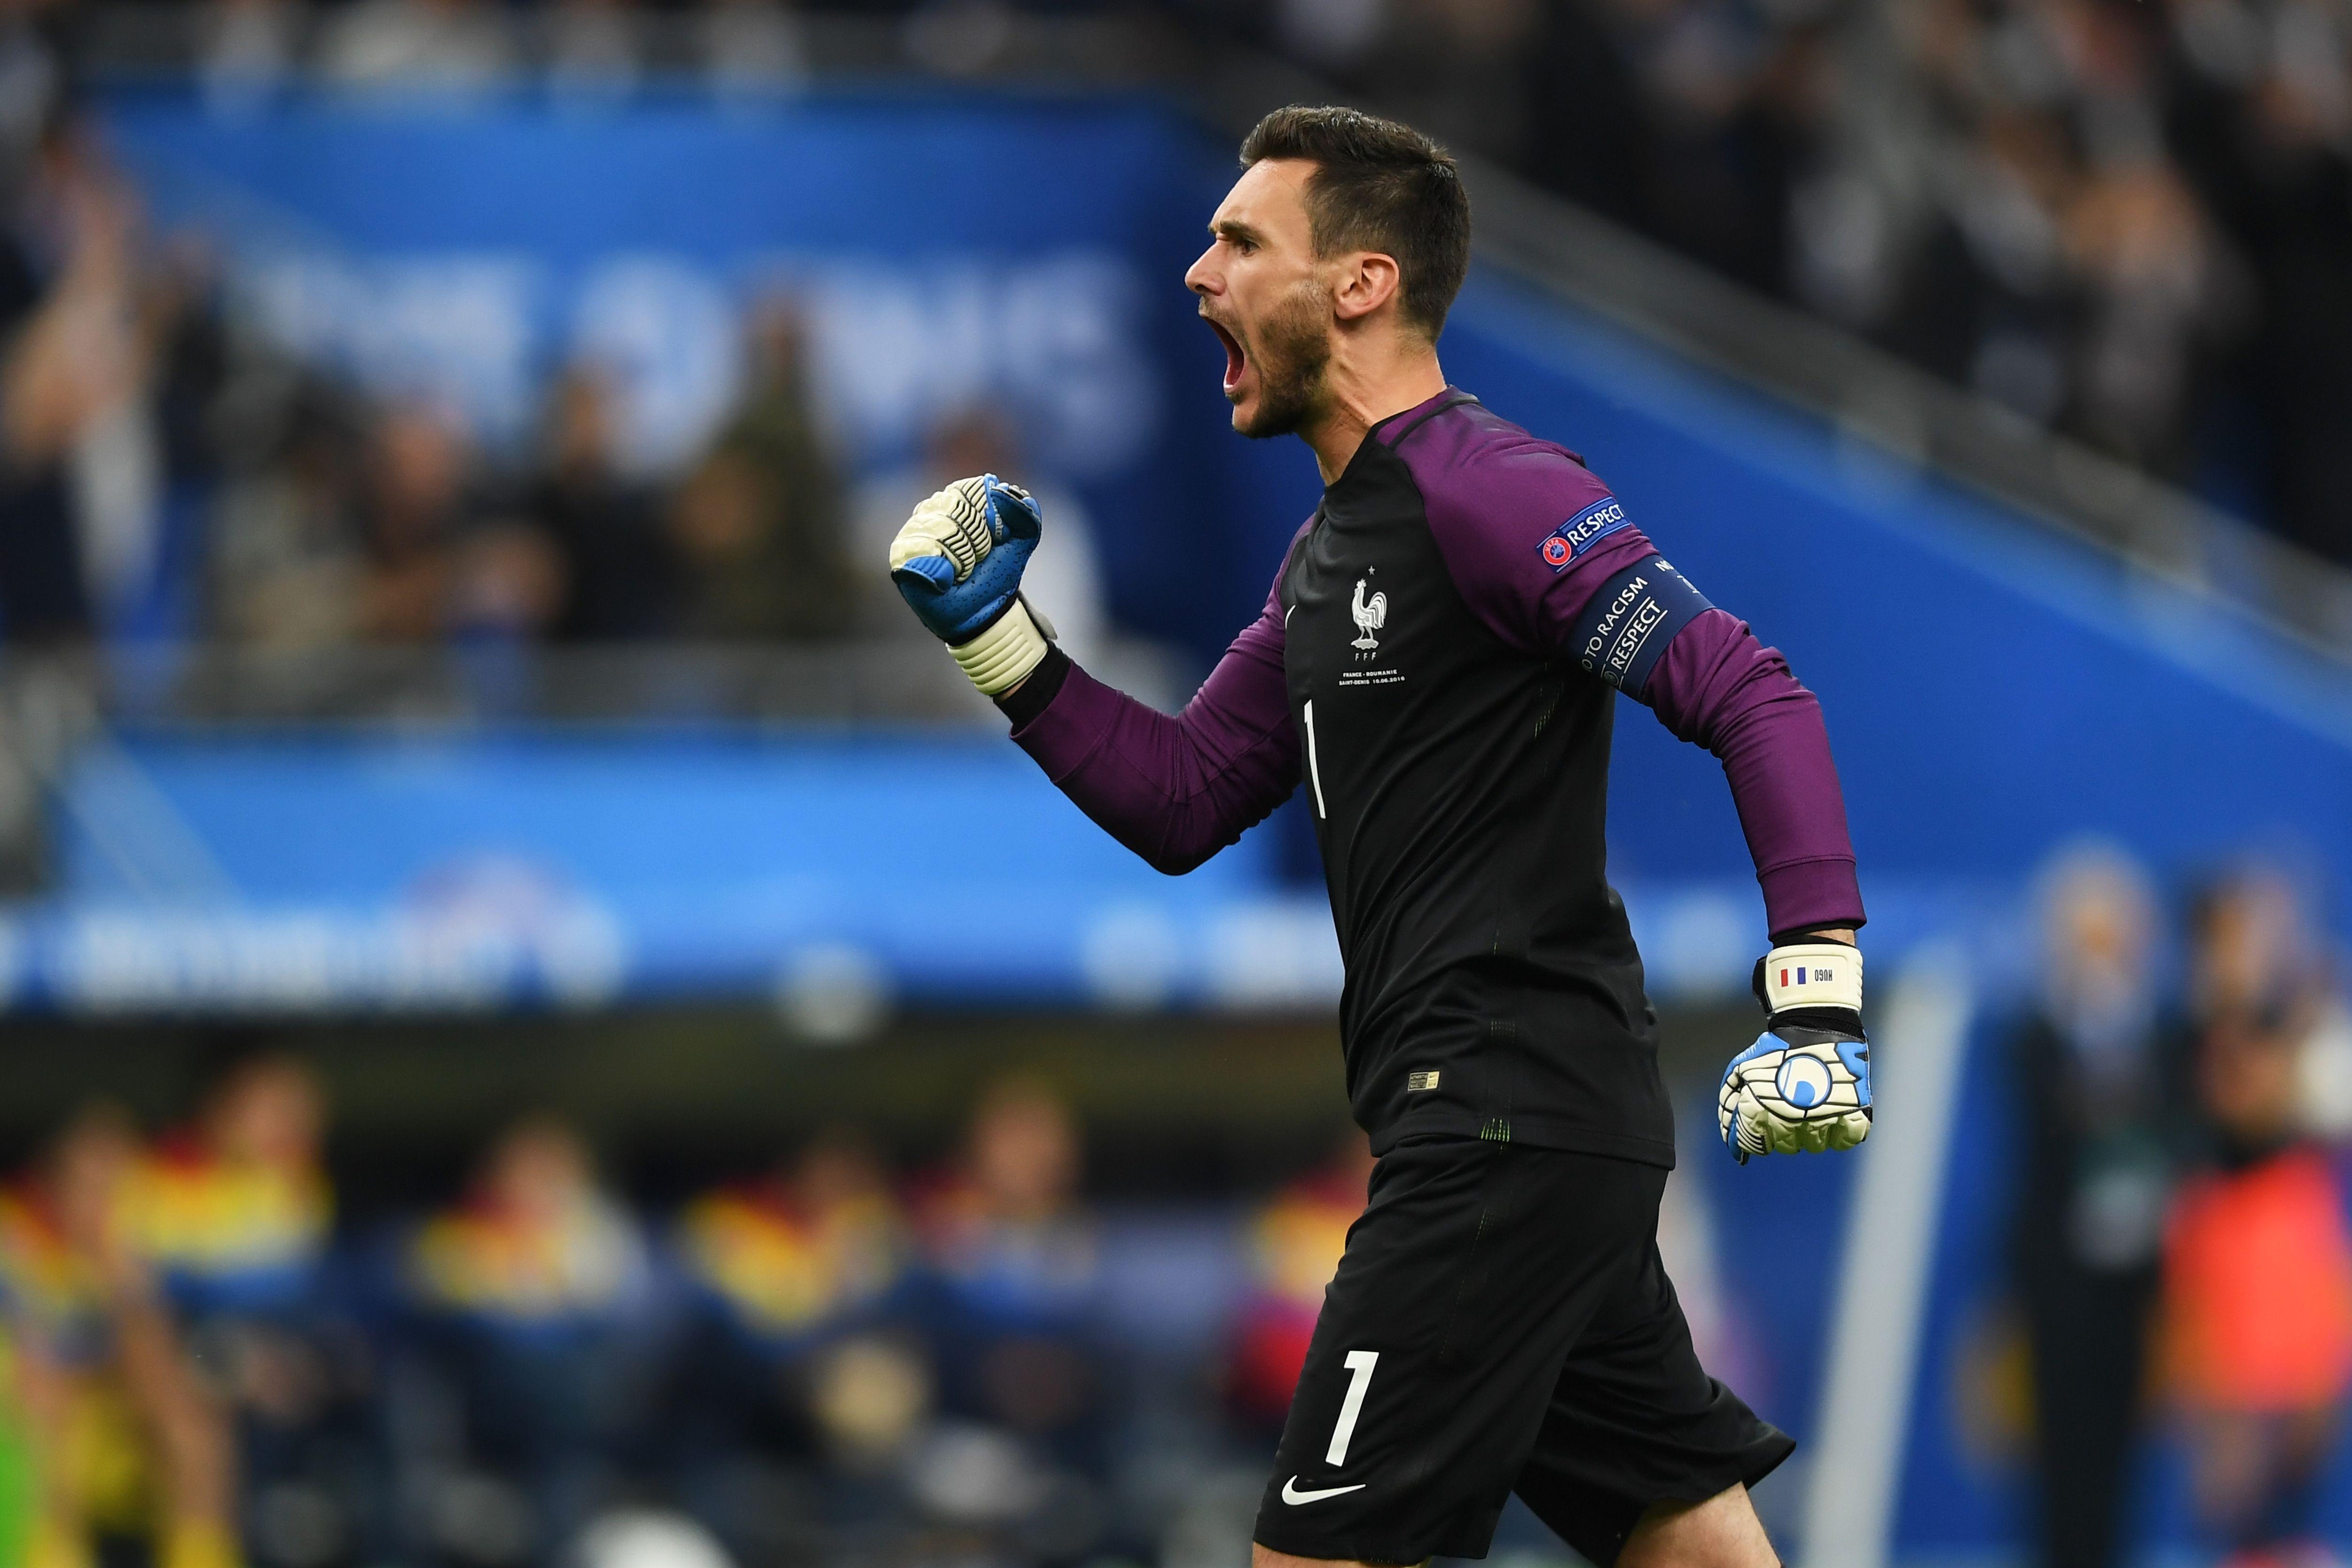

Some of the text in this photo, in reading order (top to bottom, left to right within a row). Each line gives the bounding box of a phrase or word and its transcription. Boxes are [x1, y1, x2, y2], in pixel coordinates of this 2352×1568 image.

[1567, 504, 1624, 546] RESPECT
[1584, 636, 1602, 657] TO
[1598, 577, 1648, 636] RACISM
[1611, 600, 1661, 670] RESPECT
[1304, 699, 1326, 819] 1
[1815, 969, 1833, 981] HUGO
[1325, 1351, 1379, 1467] 1
